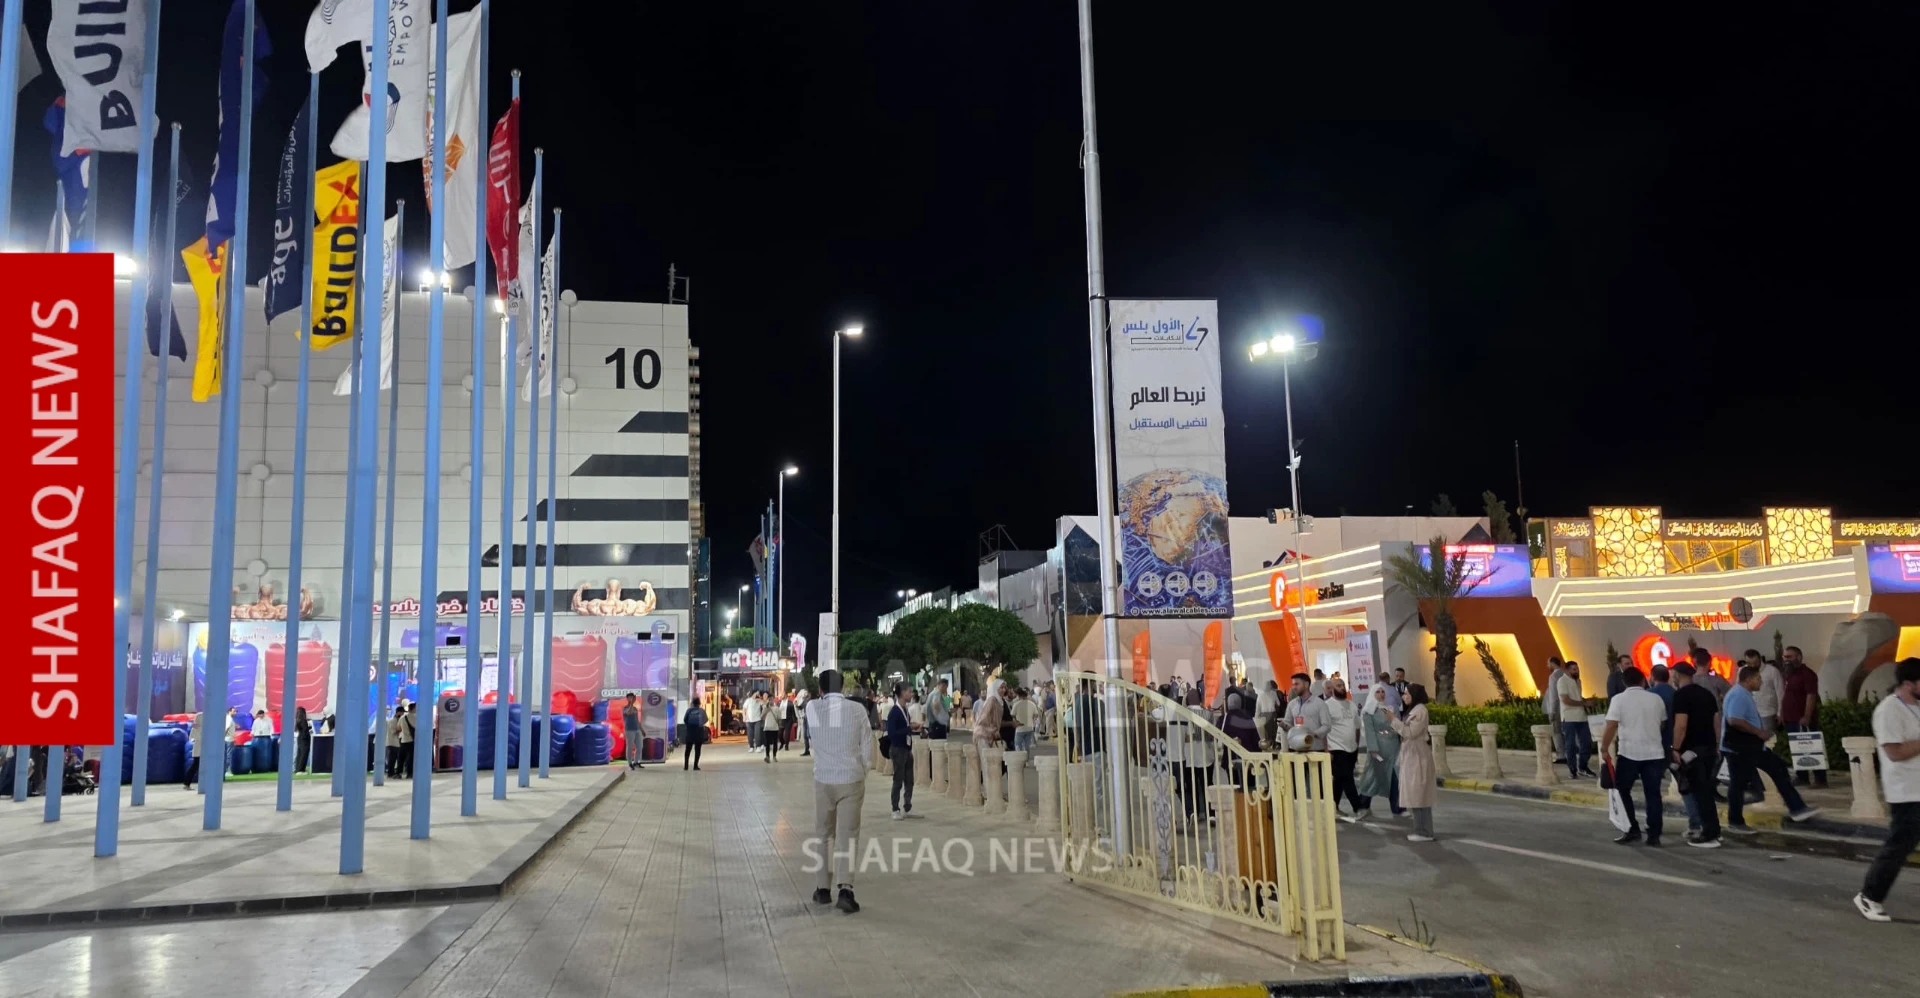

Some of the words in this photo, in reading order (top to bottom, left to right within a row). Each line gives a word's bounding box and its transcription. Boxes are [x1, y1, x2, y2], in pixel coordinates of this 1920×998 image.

[313, 174, 359, 337] BUILDEX
[1122, 320, 1148, 334] بلس
[1152, 317, 1180, 334] الأول
[605, 347, 661, 390] 10
[1129, 386, 1169, 411] العالم
[1173, 386, 1206, 406] نربط
[1129, 417, 1174, 431] المستقبل
